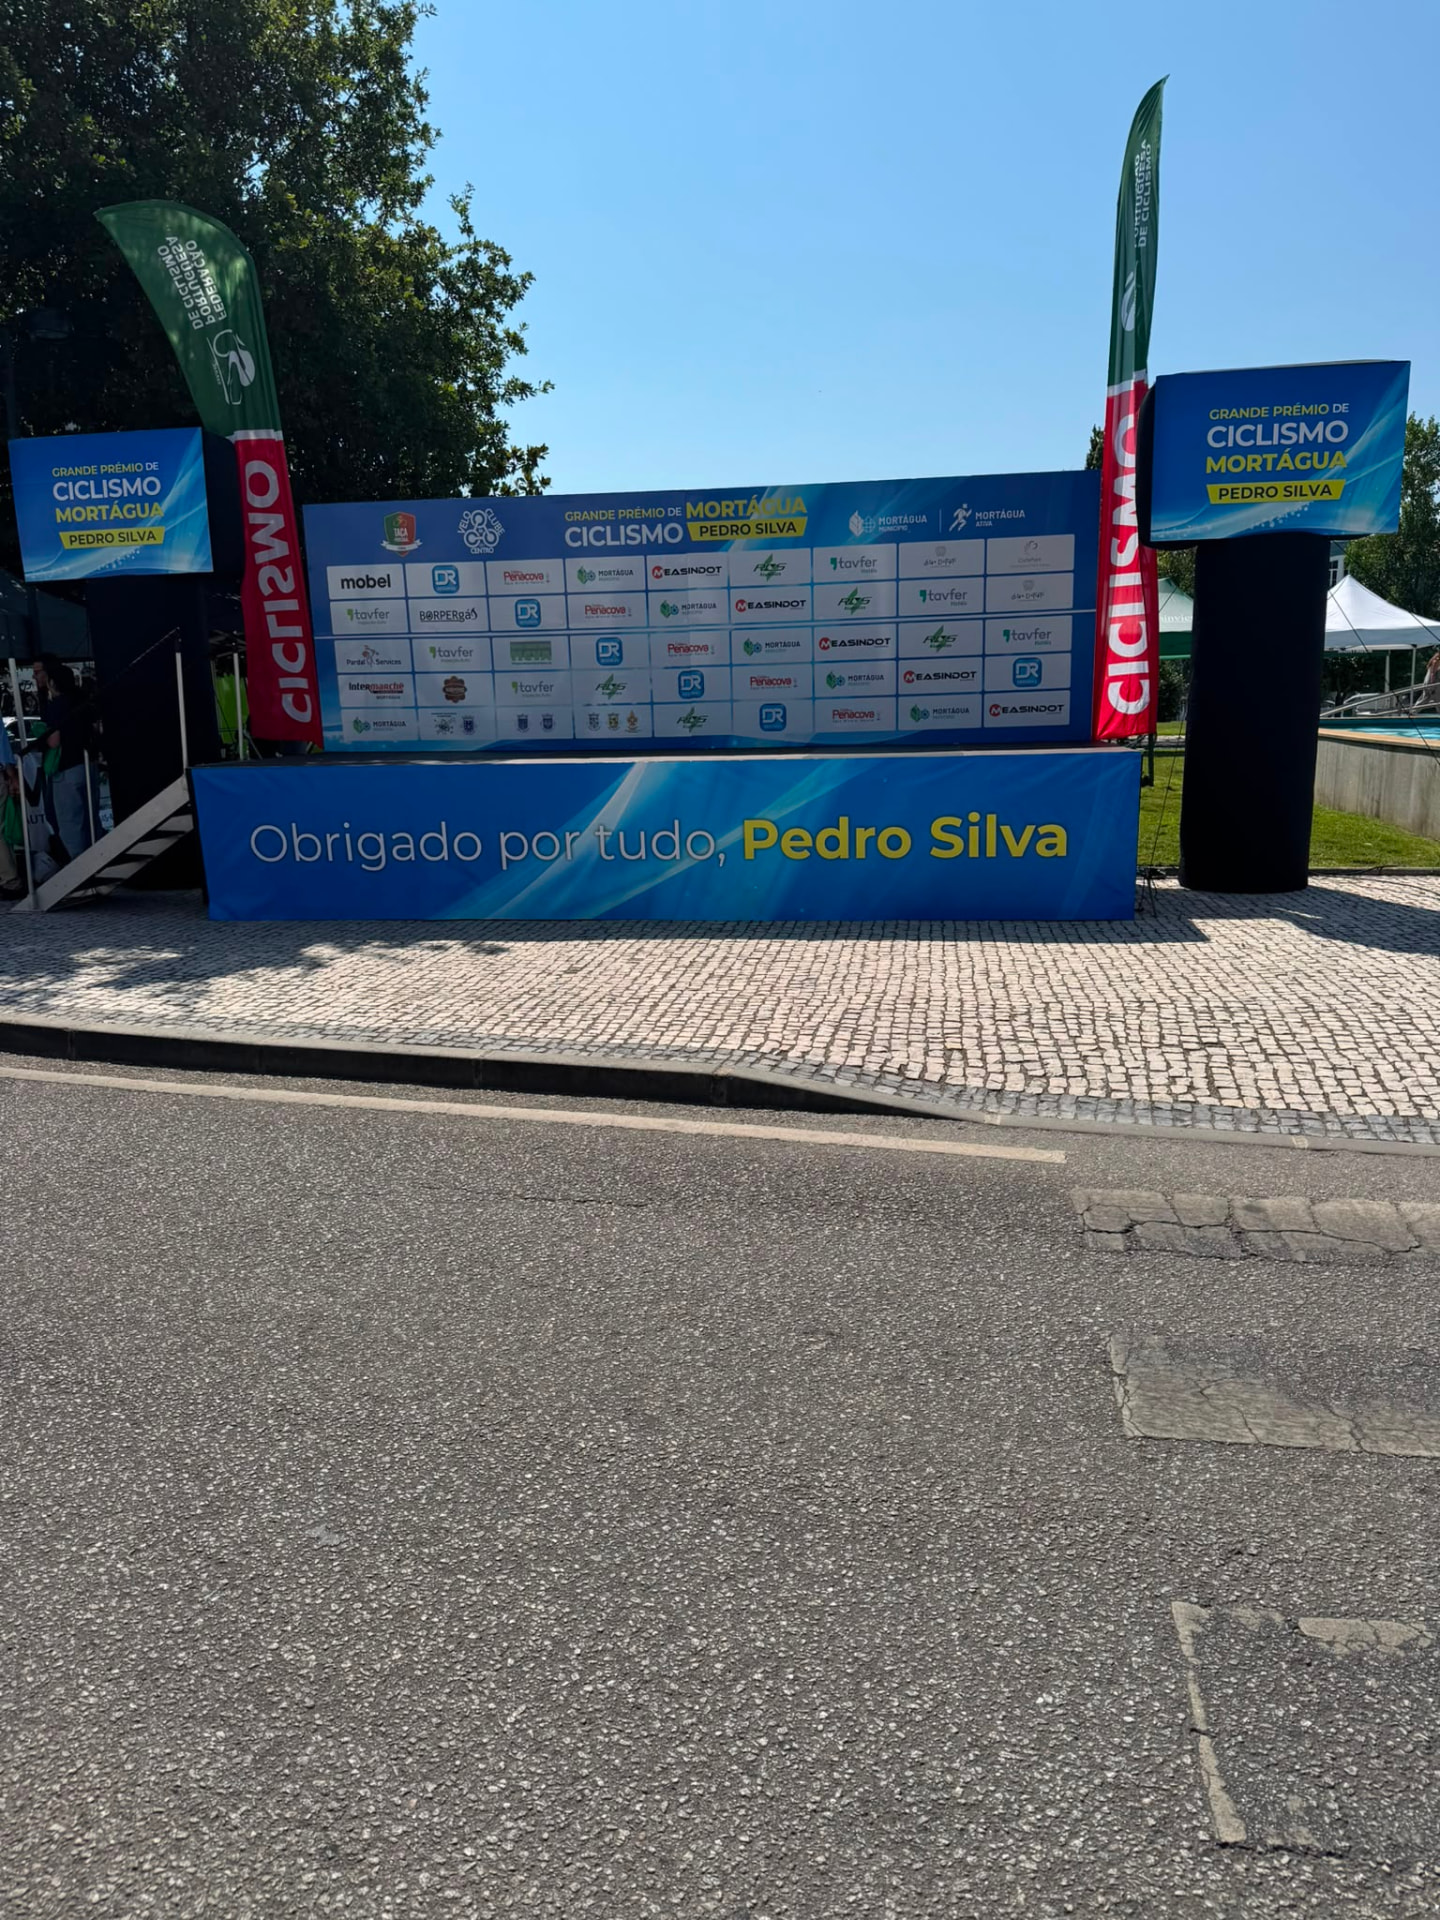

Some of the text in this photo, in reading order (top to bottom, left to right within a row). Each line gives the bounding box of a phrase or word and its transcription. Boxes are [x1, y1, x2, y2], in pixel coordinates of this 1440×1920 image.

[1138, 144, 1152, 247] DE CICLISMO
[1209, 402, 1349, 420] GRANDE PRÉMIO DE
[1206, 420, 1349, 448] CICLISMO
[1206, 448, 1347, 473] MORTÁGUA
[52, 461, 159, 478] GRANDE PRÉMIO DE
[52, 476, 161, 501] CICLISMO
[1218, 483, 1332, 500] PEDRO SILVA
[55, 501, 164, 523] MORTÁGUA
[564, 505, 682, 522] GRANDE PRÉMIO DE
[686, 494, 807, 519] MORTÁGUA
[975, 508, 1026, 520] MORTÁGUA
[457, 508, 505, 536] VELO CLUBE
[878, 514, 928, 525] MORTÁGUA
[975, 520, 993, 528] ATIVA
[564, 522, 684, 547] CICLISMO
[699, 520, 797, 537] PEDRO SILVA
[69, 530, 157, 546] PEDRO SILVA
[470, 547, 494, 555] CENTRO
[838, 556, 877, 569] tavfer
[598, 568, 634, 577] MORTÁGUA
[341, 574, 391, 589] mobel
[928, 589, 968, 601] tavfer
[354, 608, 390, 620] tavfer
[1010, 628, 1052, 641] tavfer
[437, 646, 474, 658] tavfer
[346, 657, 402, 666] Pardal Services
[518, 681, 554, 693] tavfer
[250, 812, 1068, 871] Obrigado por tudo, Pedro Silva
